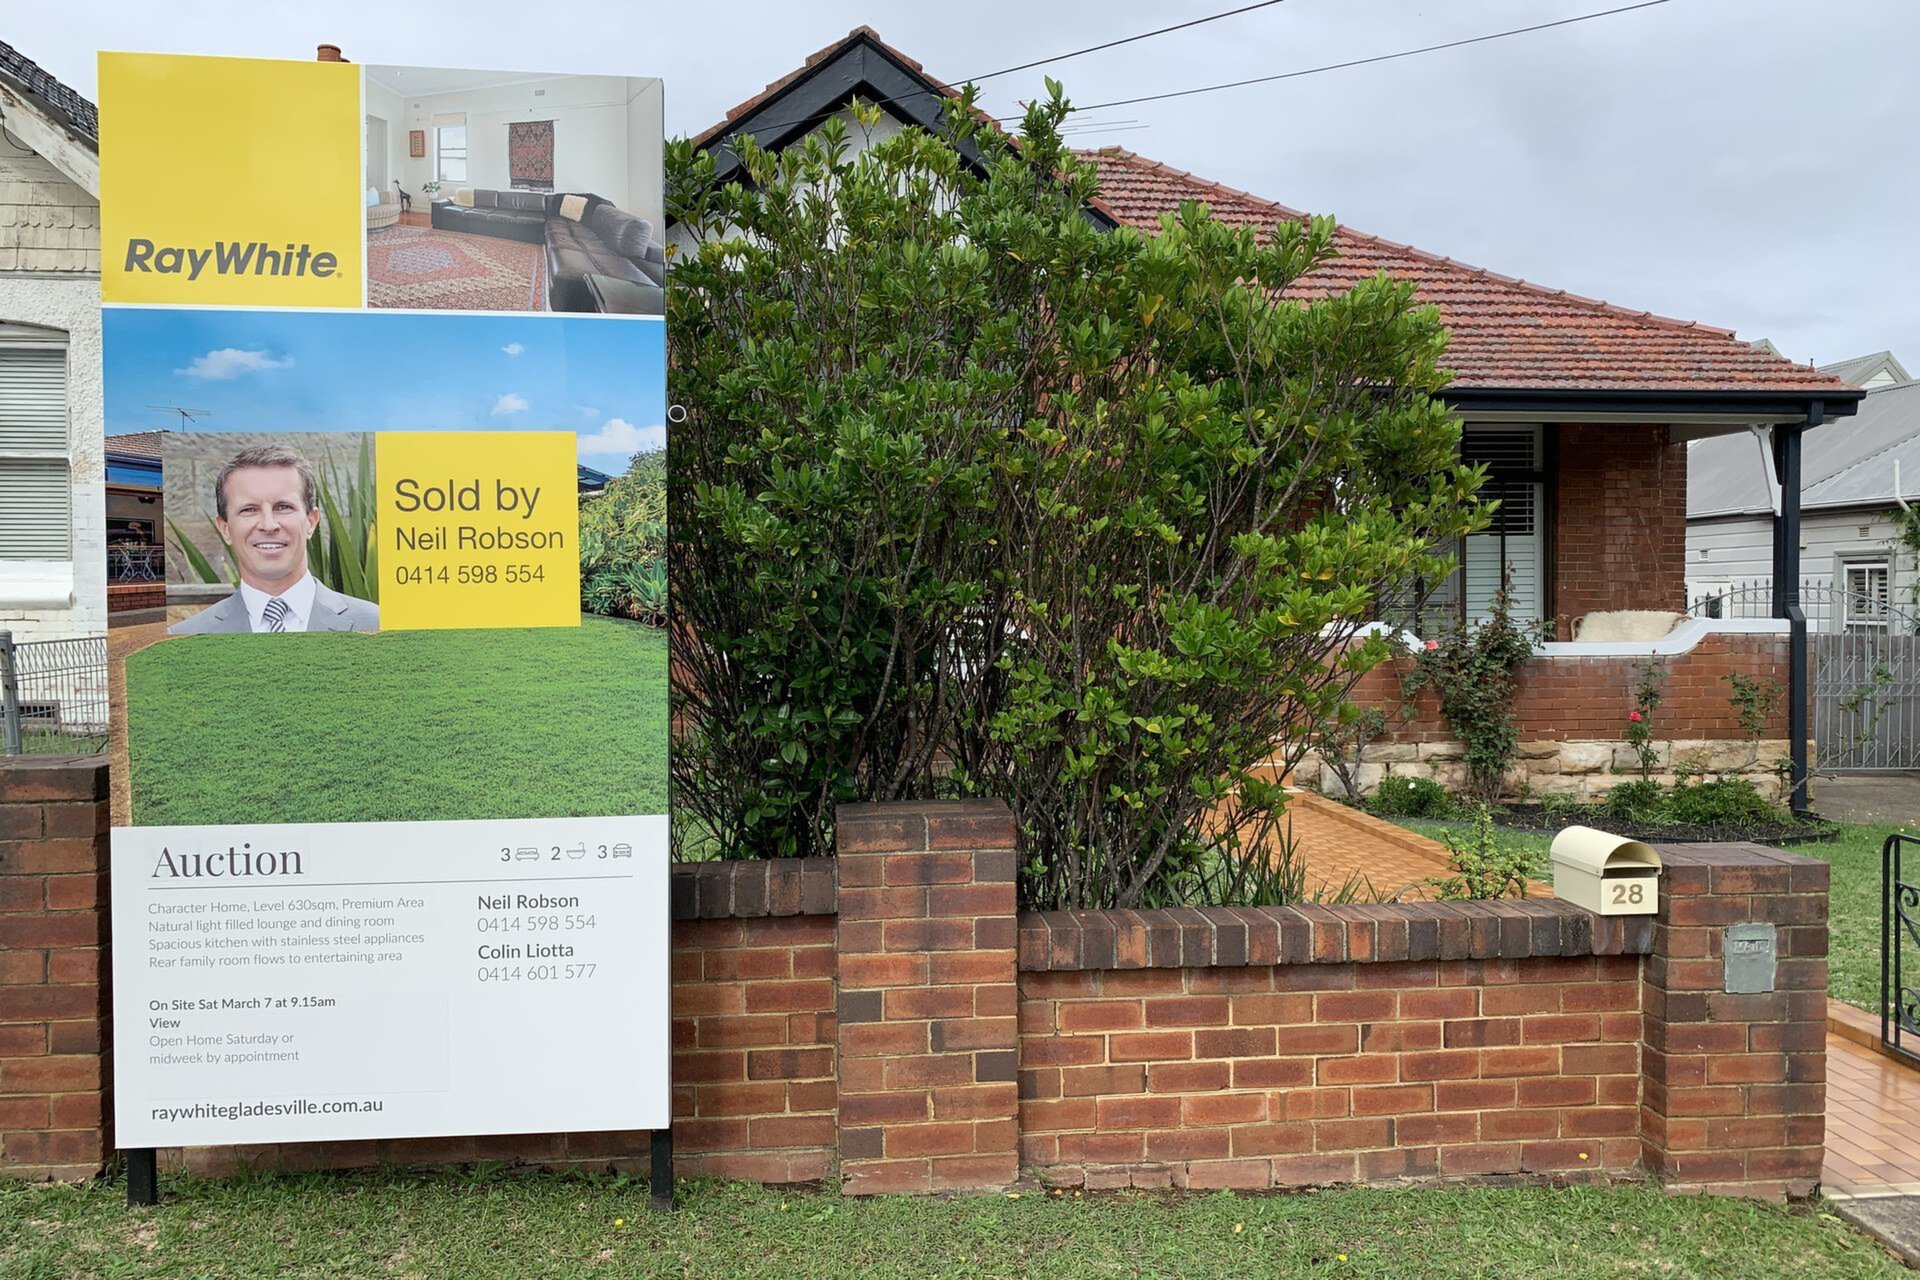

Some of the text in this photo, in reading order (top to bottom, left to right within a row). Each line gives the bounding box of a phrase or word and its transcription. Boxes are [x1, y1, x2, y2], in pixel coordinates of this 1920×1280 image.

[395, 478, 541, 519] Sold by
[396, 526, 563, 550] Neil Robson
[396, 564, 545, 585] 0414 598 554
[151, 843, 304, 878] Auction
[500, 844, 608, 862] 3 2 3
[478, 893, 579, 910] Neil Robson
[1612, 884, 1643, 904] 28
[148, 902, 208, 915] Character
[253, 900, 285, 912] Level
[342, 897, 394, 910] Premium
[396, 897, 424, 908] Area
[148, 915, 395, 934] Natural light filled lounge and dining room
[477, 914, 597, 933] 0414 598 554
[148, 932, 425, 952] Spacious kitchen with stainless steel appliances
[478, 943, 574, 960] Colin Liotta
[149, 951, 403, 969] Rear family room flows to entertaining area
[477, 963, 597, 982] 0414 601 577
[149, 996, 336, 1011] On Site Sat March 7 at 9.15am
[149, 1017, 181, 1029] View
[149, 1032, 295, 1048] Open Home Saturday or
[149, 1050, 300, 1065] midweek by appointment
[150, 1098, 384, 1122] raywhitegladesville.com.au
